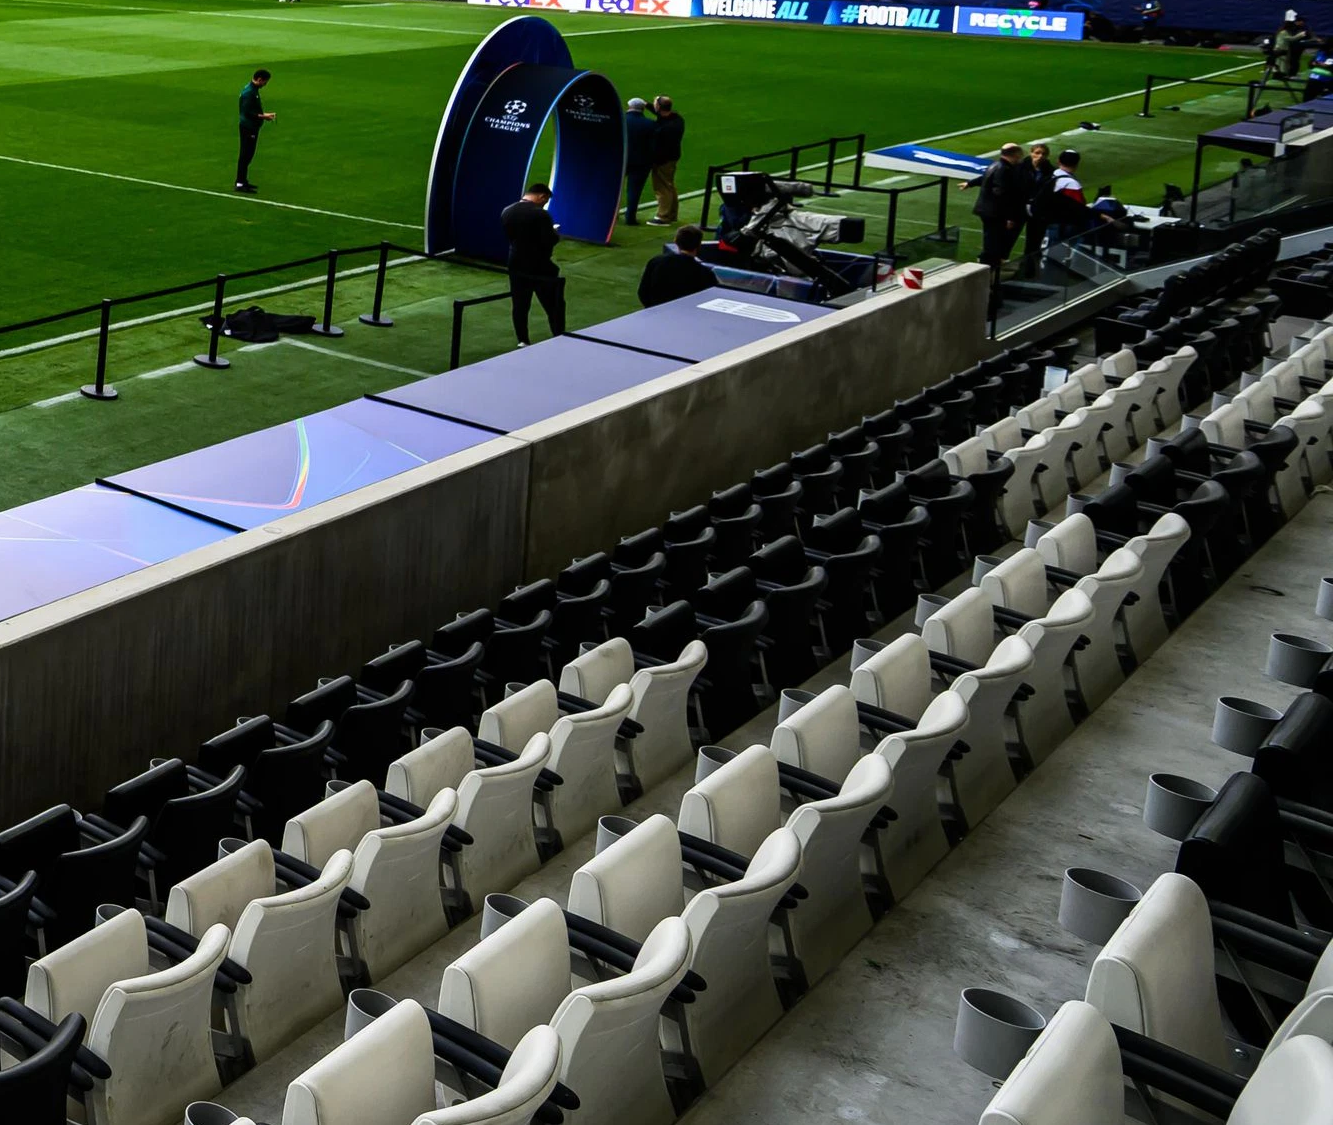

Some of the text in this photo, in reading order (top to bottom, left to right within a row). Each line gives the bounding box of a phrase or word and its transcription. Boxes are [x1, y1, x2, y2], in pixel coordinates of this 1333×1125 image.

[777, 0, 808, 20] ALL
[840, 4, 939, 28] #FOOTBALL
[969, 13, 1067, 33] RECYCLE
[484, 116, 531, 129] CHAMPIONS
[490, 123, 521, 133] LEAGUE
